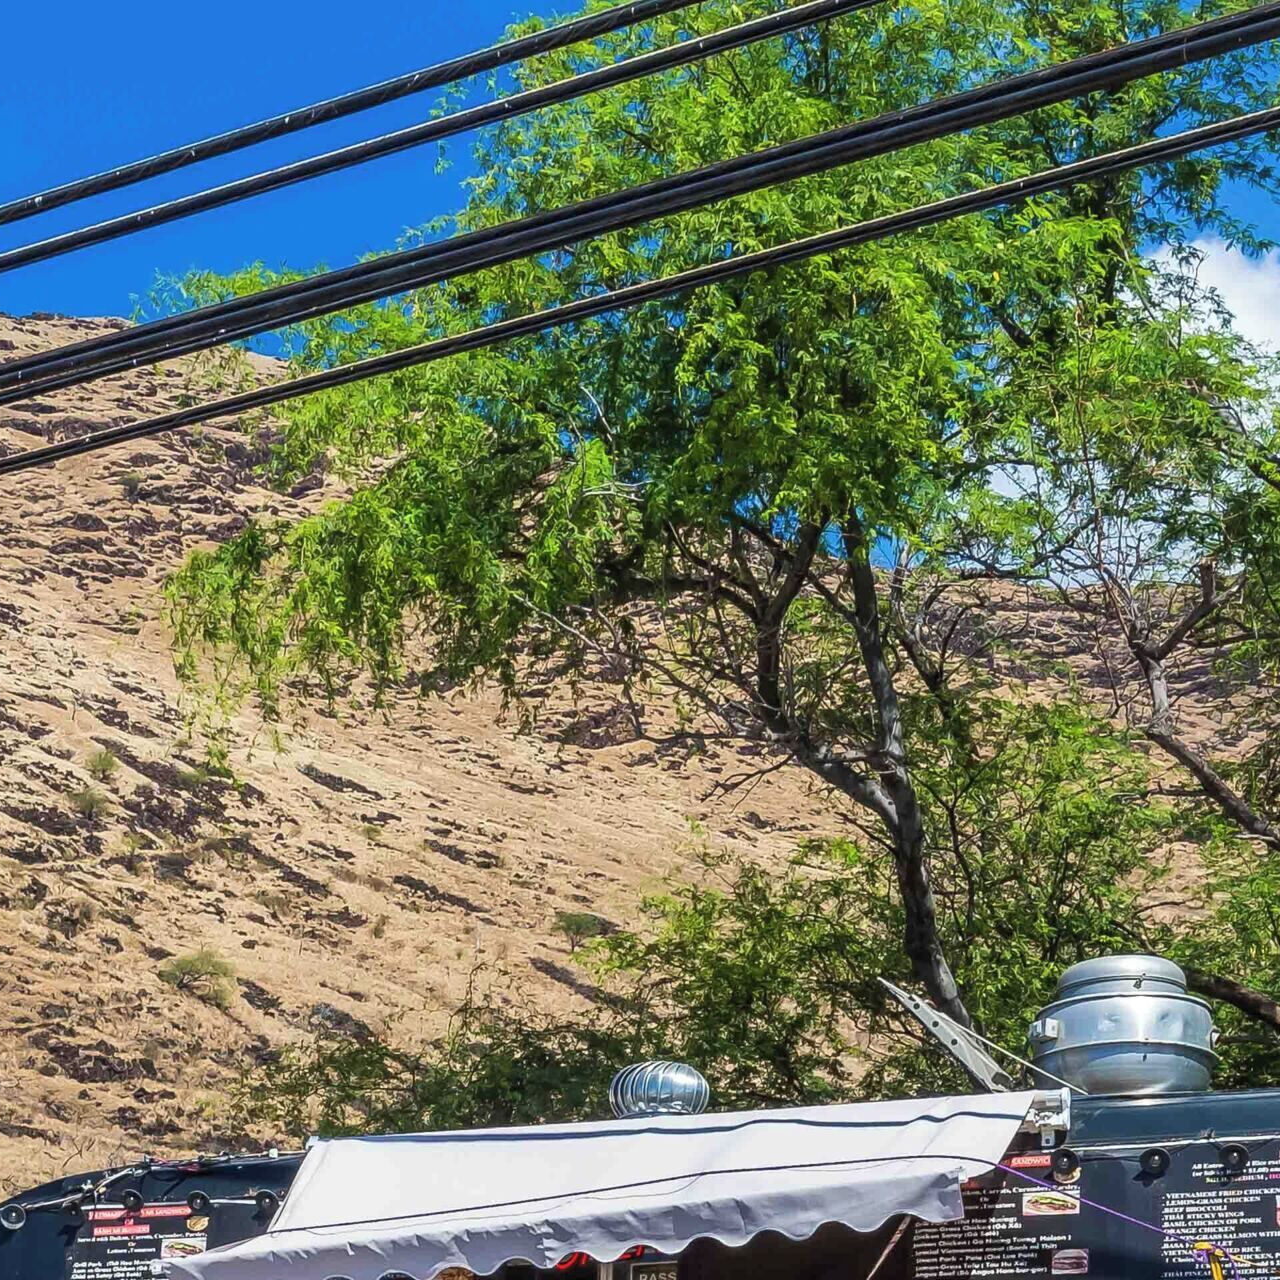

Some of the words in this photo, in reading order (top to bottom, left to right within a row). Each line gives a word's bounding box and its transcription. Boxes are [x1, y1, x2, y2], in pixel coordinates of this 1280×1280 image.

[1166, 1191, 1217, 1200] VIETNAMESE
[1244, 1188, 1280, 1196] CHICKEN
[1166, 1199, 1223, 1207] LEMON-GRASS
[1186, 1205, 1227, 1213] BROCCOLI
[1223, 1231, 1257, 1239] SALMON
